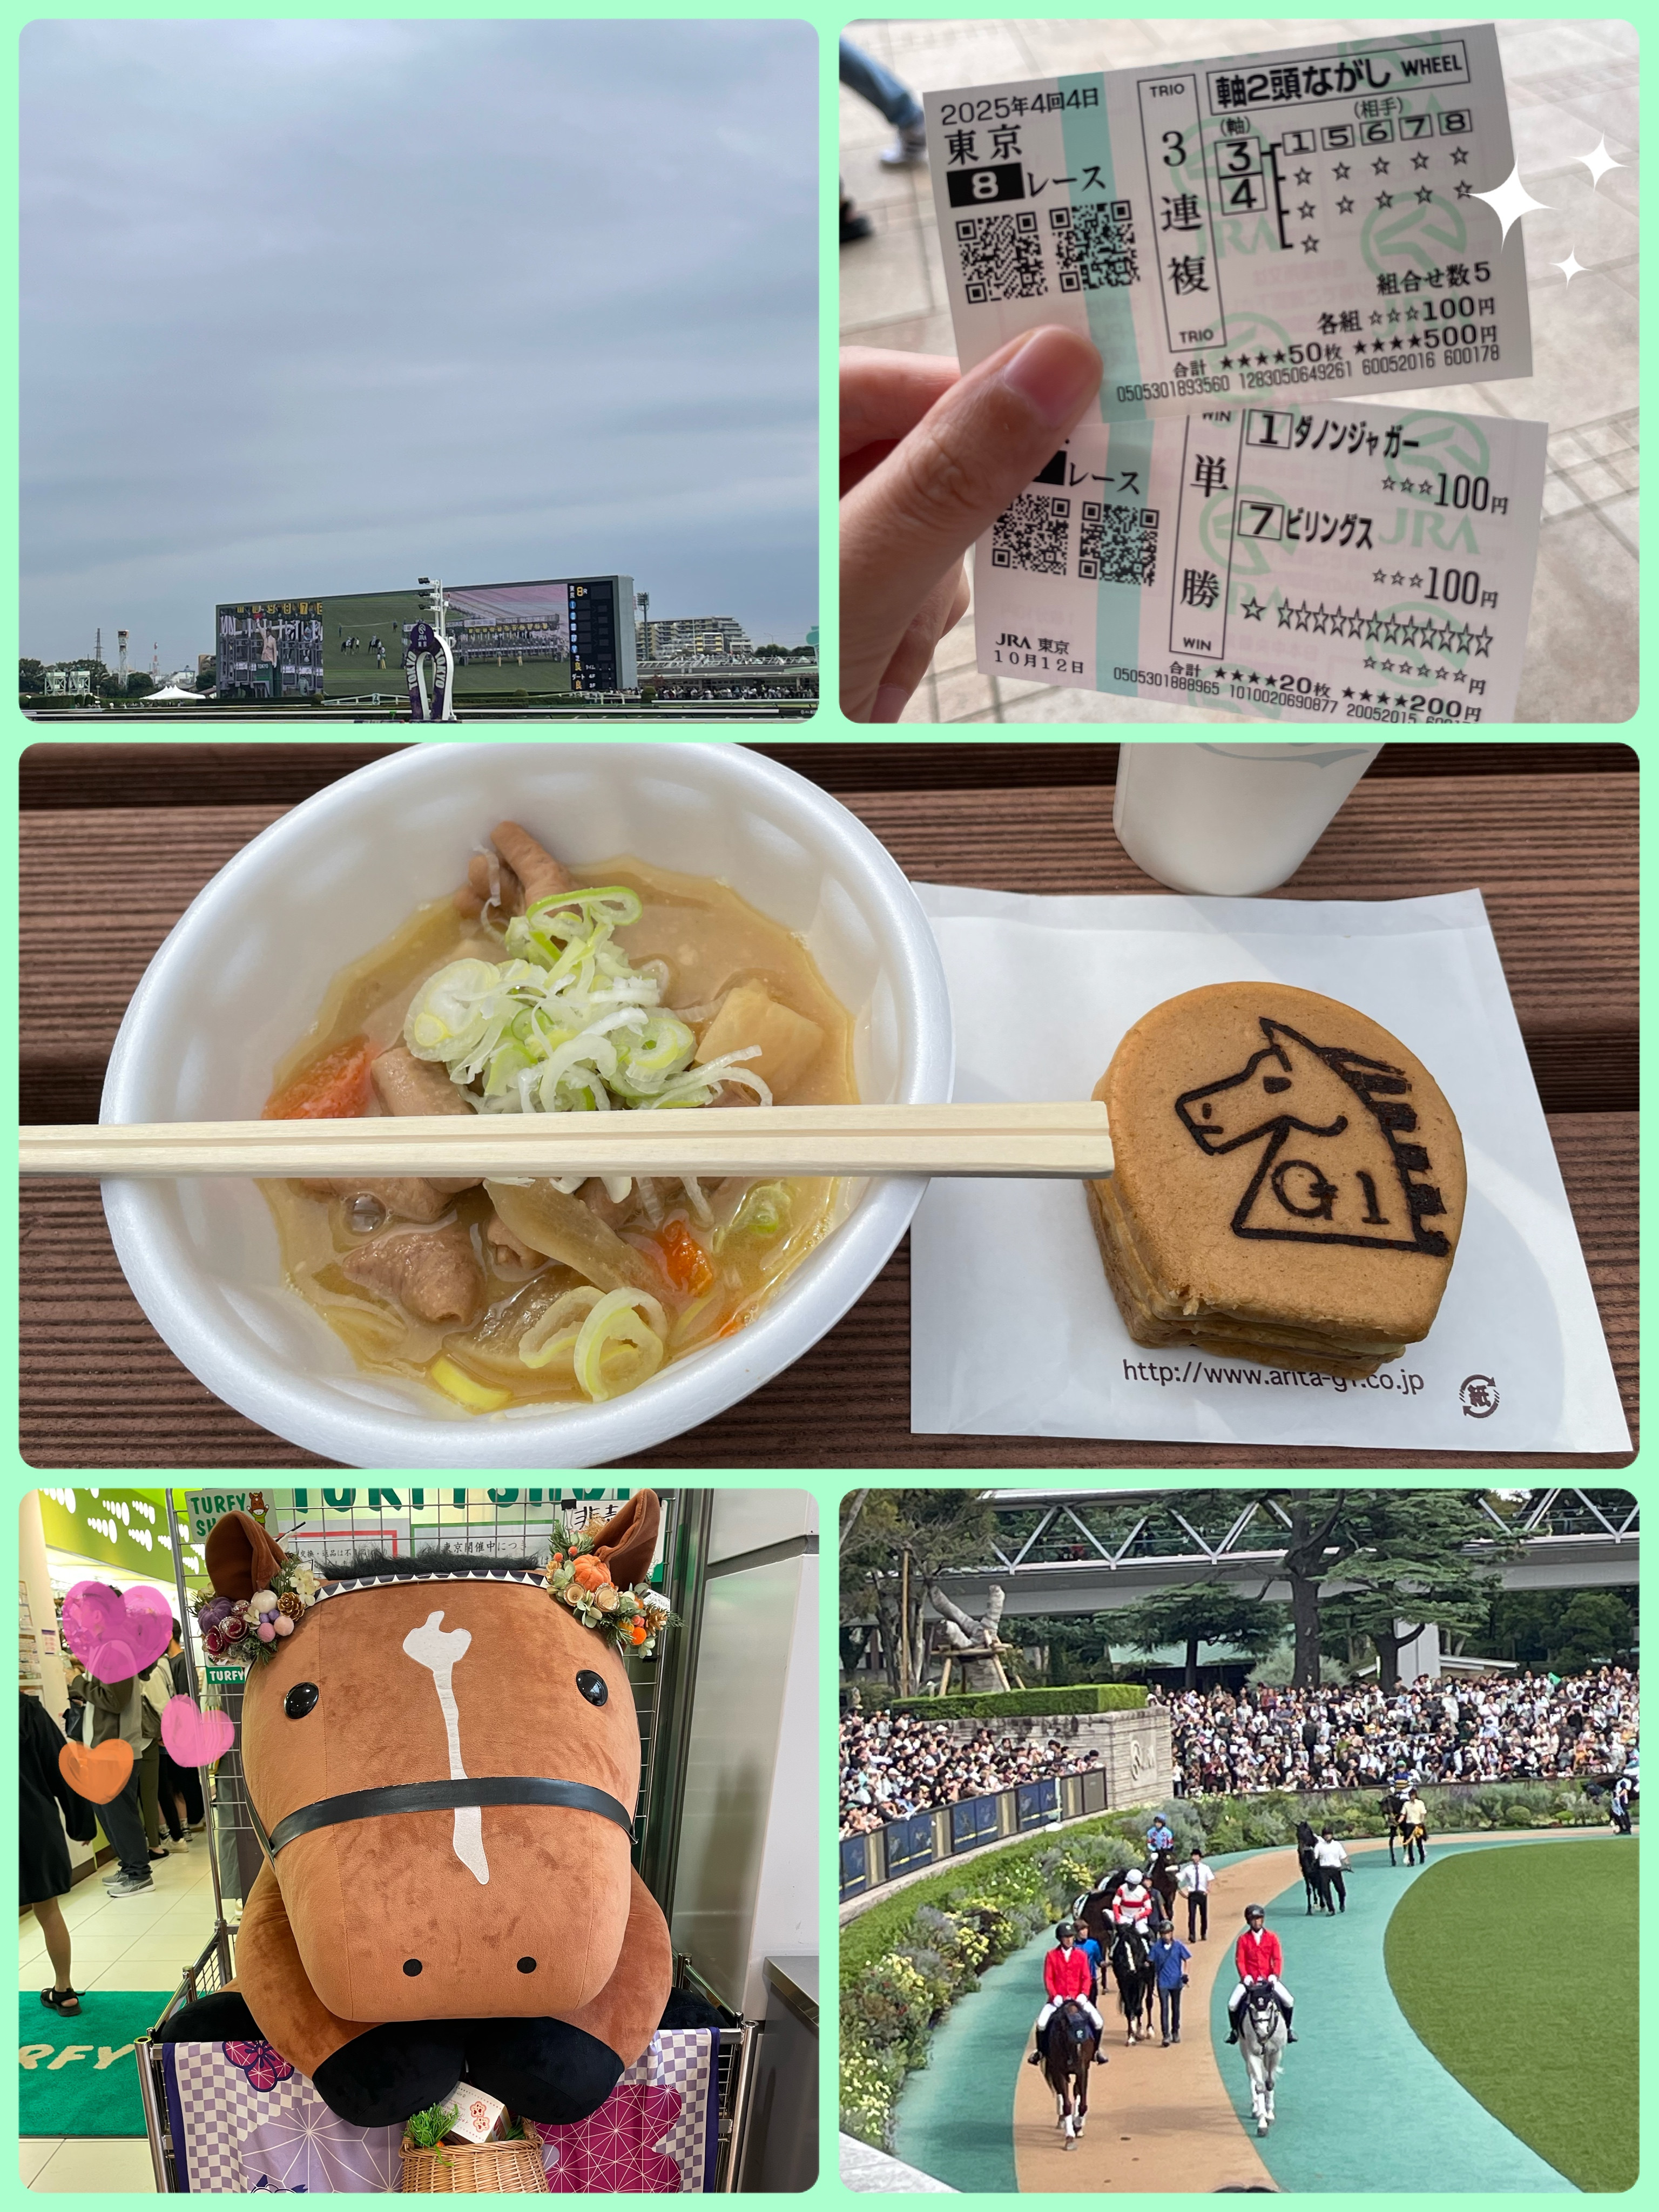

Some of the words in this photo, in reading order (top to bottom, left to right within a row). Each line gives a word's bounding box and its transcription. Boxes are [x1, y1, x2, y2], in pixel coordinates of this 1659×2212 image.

[1150, 84, 1185, 98] TRIO
[1216, 58, 1391, 107] 軸2頭ながし
[1401, 55, 1462, 78] WHEEL
[941, 87, 1099, 126] 2025年4回4日
[1354, 97, 1404, 118] (相手)
[944, 124, 1023, 166] 東京
[1220, 116, 1251, 137] (軸)
[1292, 133, 1309, 152] 1
[1328, 129, 1348, 146] 5
[1367, 124, 1388, 142] 6
[1405, 118, 1425, 137] 7
[1446, 113, 1465, 131] 8
[1226, 141, 1251, 172] 3
[972, 171, 999, 199] 8
[1027, 165, 1106, 198] レース
[1230, 178, 1257, 209] 4
[1161, 131, 1210, 296] 3連複
[1377, 261, 1492, 296] 組合せ数5
[1318, 311, 1361, 335] 各組
[1423, 296, 1495, 321] 100円
[1172, 359, 1206, 377] 合計
[1287, 341, 1343, 365] 50枚
[1424, 323, 1498, 348] 500円
[1180, 328, 1215, 344] TRIO
[1117, 375, 1230, 403] 0505301893560
[1239, 360, 1352, 389] 1283050649261
[1362, 354, 1435, 376] 60052016
[1444, 344, 1500, 366] 600178
[1202, 411, 1231, 423] WIN
[1259, 414, 1278, 444] 1
[1293, 415, 1420, 459] ダノンジャガー
[1070, 462, 1140, 495] レース
[1435, 472, 1509, 516] 100円
[1179, 454, 1230, 609] 単勝
[1249, 503, 1275, 536] 7
[1285, 508, 1374, 550] ビリングス
[1379, 506, 1481, 555] JRA
[1425, 566, 1499, 609] 100円
[994, 650, 1084, 674] 10月12日
[995, 632, 1032, 650] JRA
[1037, 637, 1070, 655] 東京
[1183, 637, 1211, 651] WIN
[406, 651, 418, 690] TOKYO
[435, 648, 446, 689] TOKYO
[1468, 678, 1486, 696] 円
[1114, 666, 1219, 695] 0505301888965
[1230, 684, 1338, 713] 1010020690877
[1346, 703, 1417, 723] 20052015
[1169, 660, 1202, 678] 合計
[1279, 673, 1331, 698] 20枚
[1409, 694, 1482, 722] 200円
[1269, 1159, 1391, 1225] G1
[190, 1493, 246, 1515] TURFY
[209, 1670, 244, 1681] TURFY
